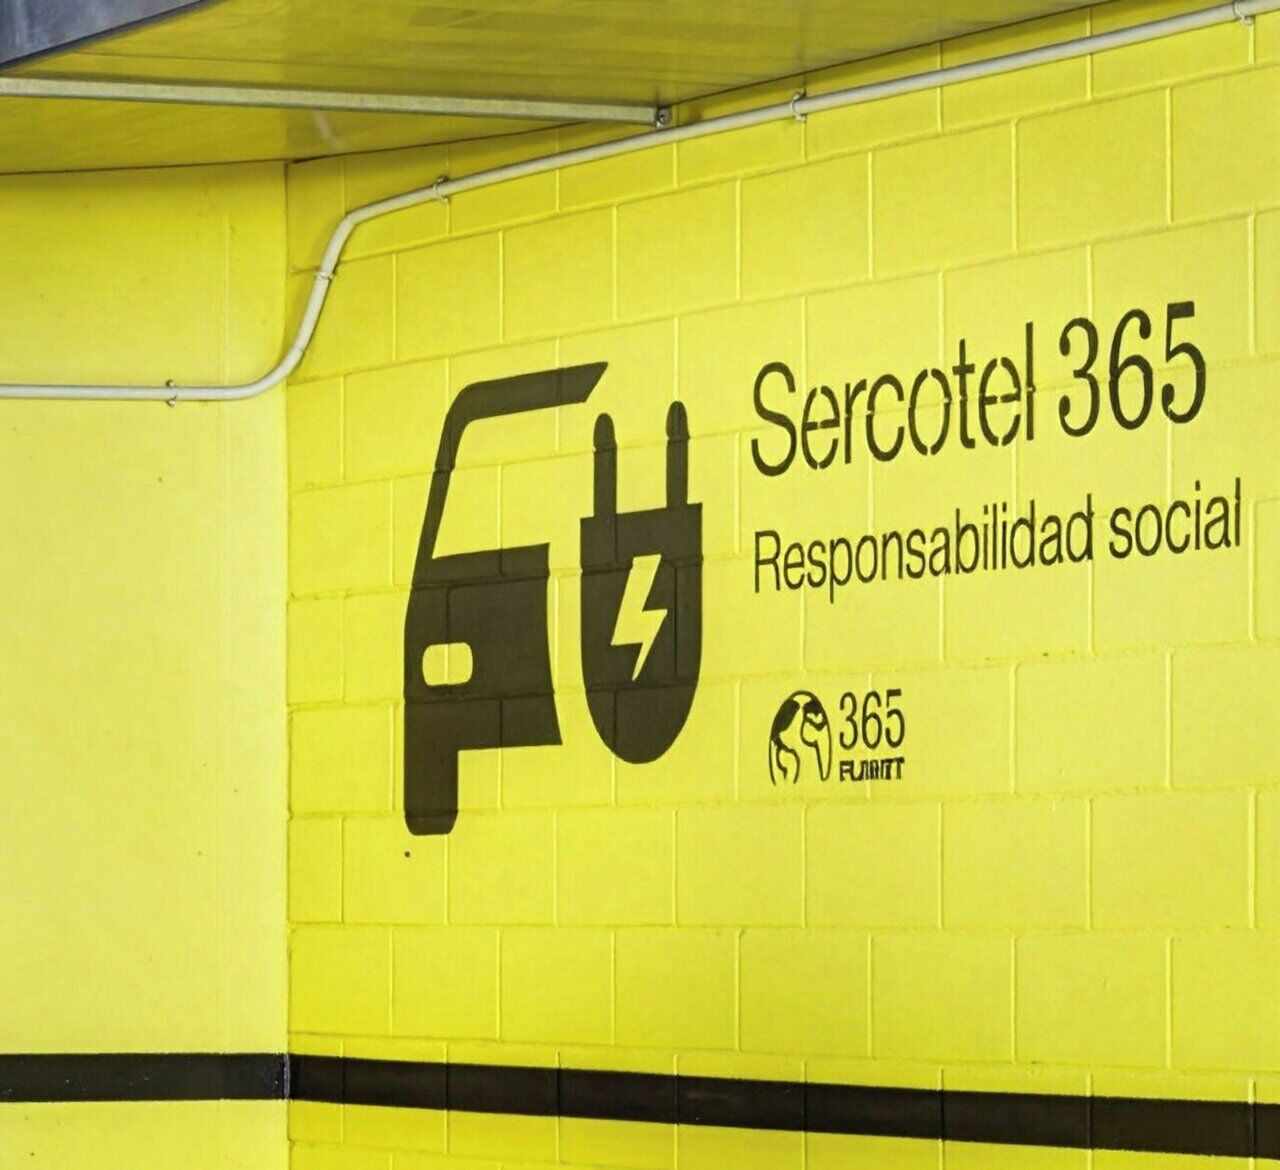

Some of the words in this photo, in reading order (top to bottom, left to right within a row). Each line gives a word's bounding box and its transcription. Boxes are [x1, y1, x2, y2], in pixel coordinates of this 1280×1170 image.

[751, 321, 1036, 477] Sercotel
[1058, 300, 1206, 437] 365
[754, 493, 1094, 603] Responsabilidad
[1109, 477, 1242, 559] social
[839, 688, 905, 750] 365
